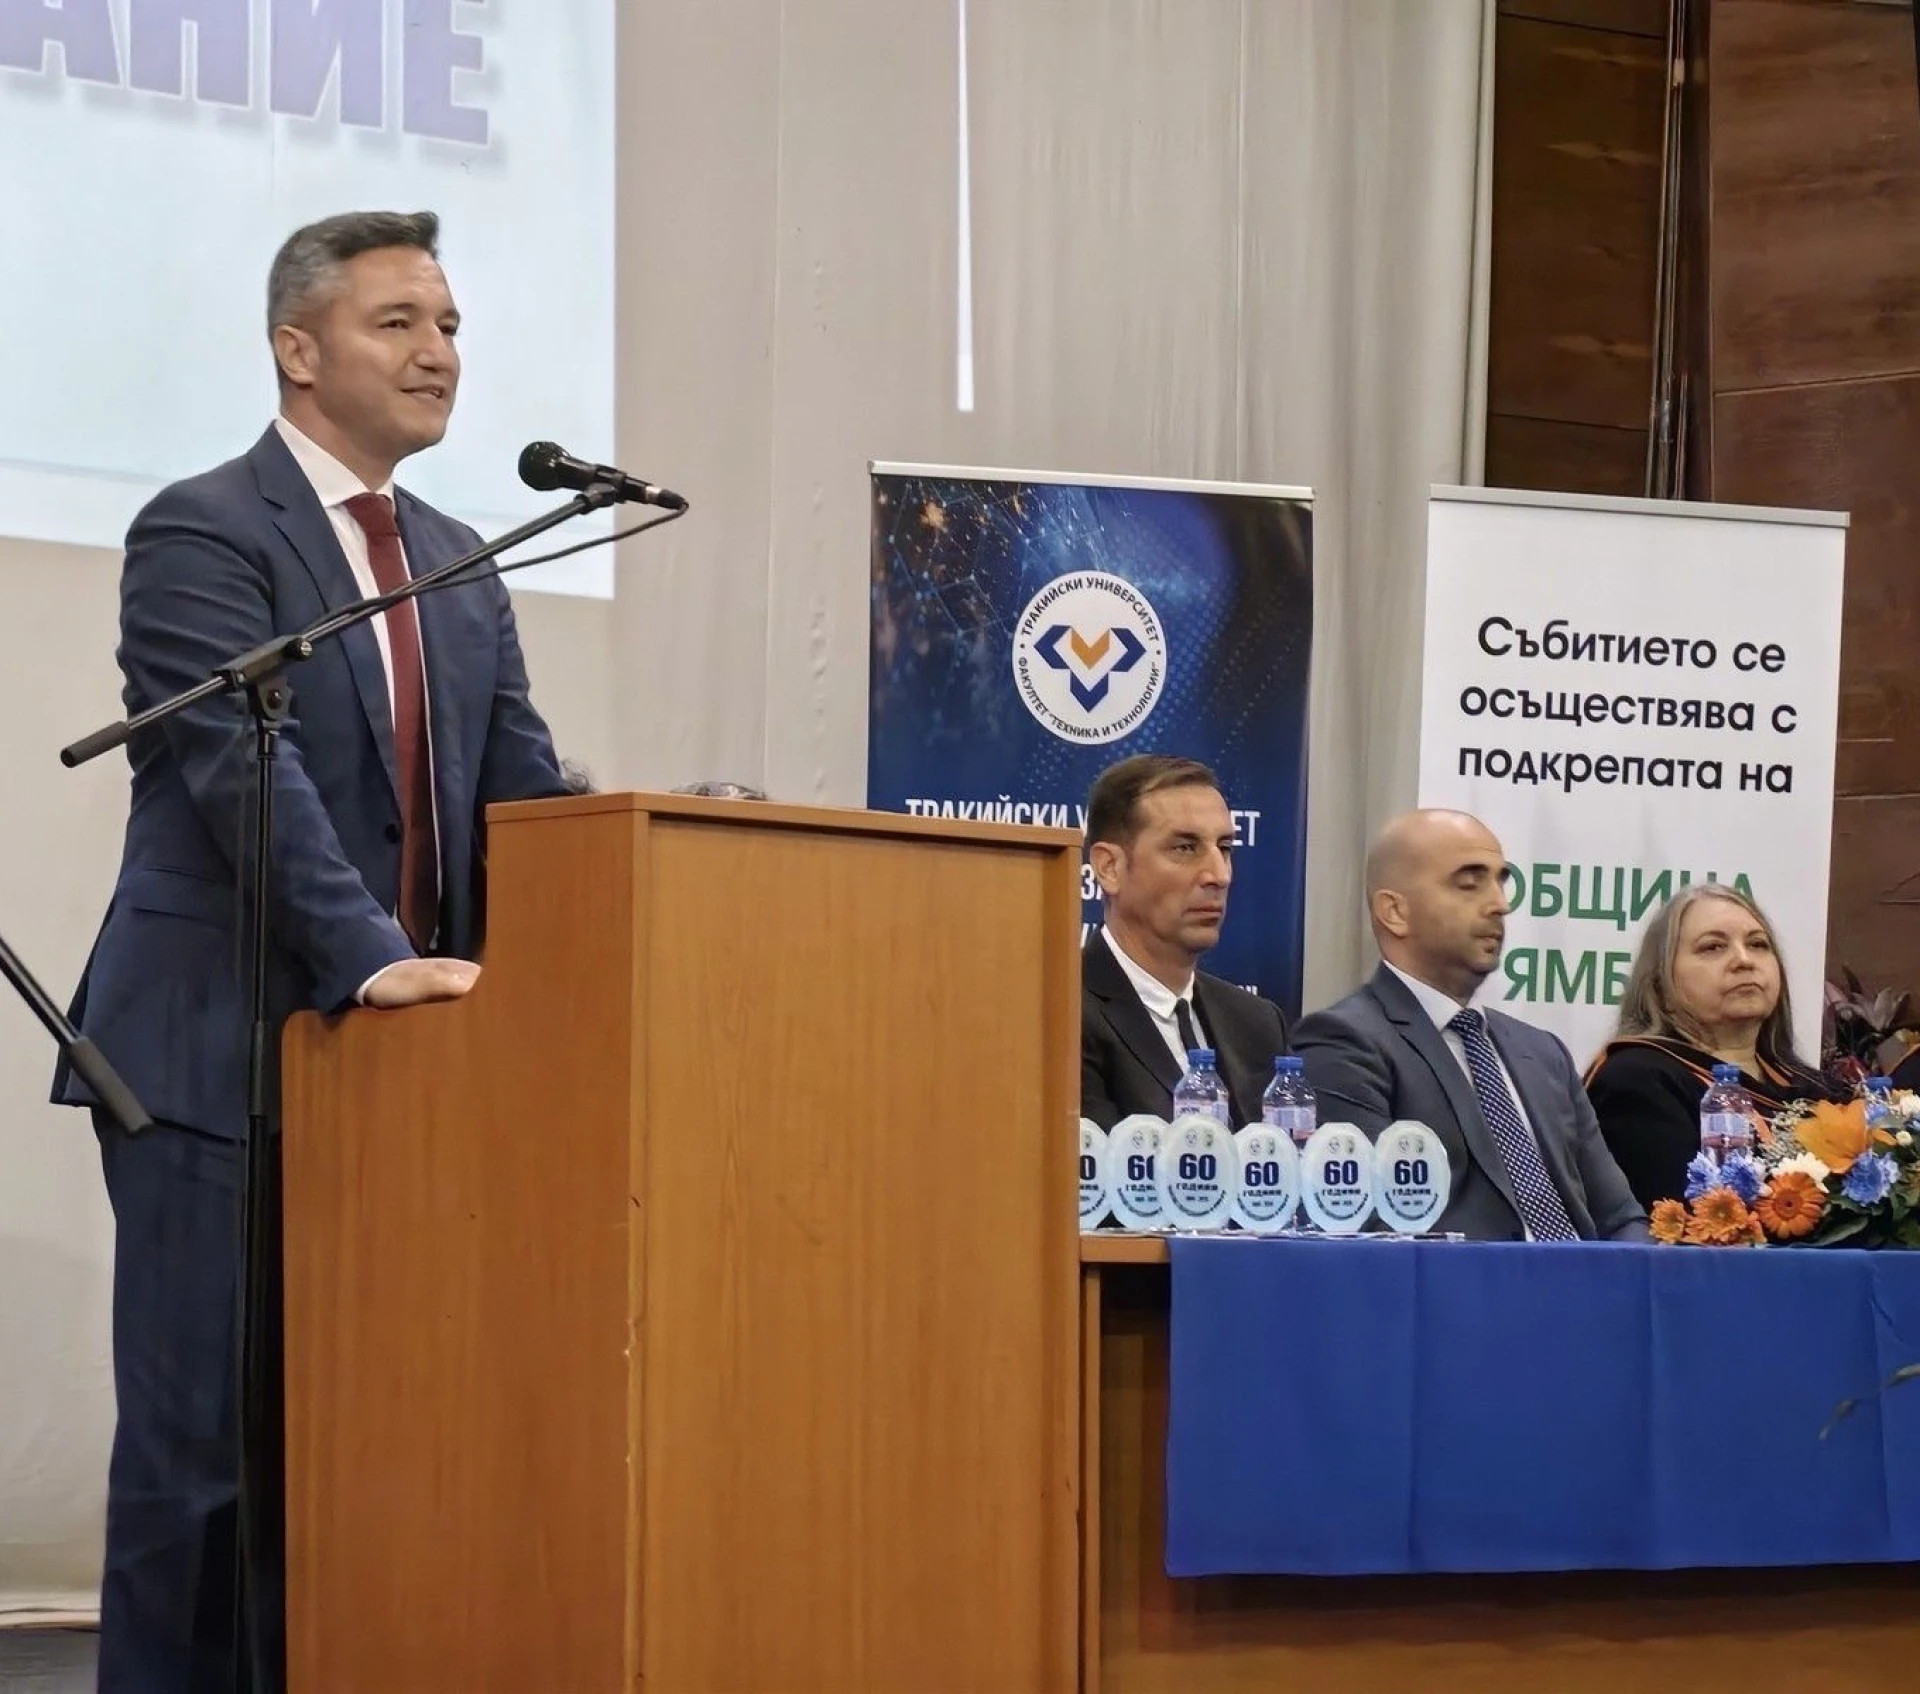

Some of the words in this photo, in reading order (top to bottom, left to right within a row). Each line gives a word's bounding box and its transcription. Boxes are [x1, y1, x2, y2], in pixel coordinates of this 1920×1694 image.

[1020, 578, 1084, 636] ТРАКИЙСКИ
[1086, 577, 1160, 642] УНИВЕРСИТЕТ
[1477, 616, 1717, 669] Събитието
[1732, 642, 1786, 672] се
[1018, 656, 1049, 718] ФАКУЛТЕТ
[1102, 726, 1112, 738] И
[1460, 686, 1755, 731] осъществява
[1771, 704, 1798, 733] с
[1459, 747, 1722, 793] подкрепата
[1739, 763, 1793, 793] на
[1504, 860, 1754, 931] БЩИ
[1503, 948, 1632, 1005] ЯМБ
[1080, 1155, 1096, 1181] 0
[1179, 1153, 1216, 1181] 60
[1245, 1161, 1280, 1187] 60
[1323, 1160, 1359, 1186] 60
[1394, 1159, 1429, 1186] 60
